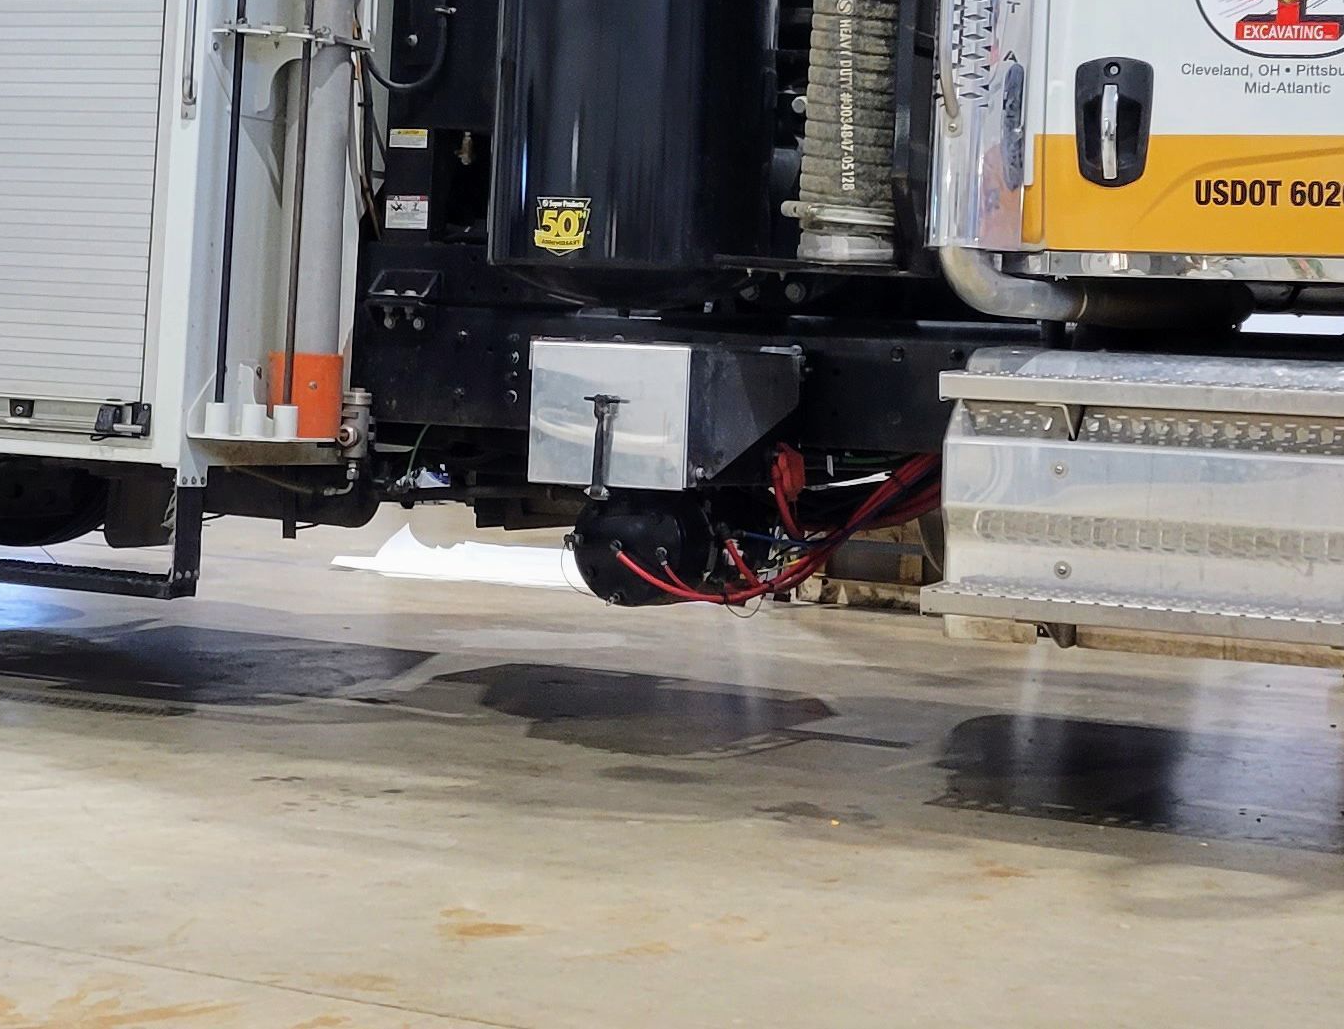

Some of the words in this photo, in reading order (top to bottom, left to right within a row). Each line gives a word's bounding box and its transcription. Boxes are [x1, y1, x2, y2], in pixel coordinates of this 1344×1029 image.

[839, 19, 852, 56] HEAVY
[1243, 24, 1324, 40] EXCAVATING
[840, 60, 853, 91] DUTY
[1181, 64, 1254, 78] Cleveland,
[1258, 64, 1280, 76] OH
[1244, 82, 1331, 94] Mid-Atlantic
[1195, 180, 1282, 206] USDOT
